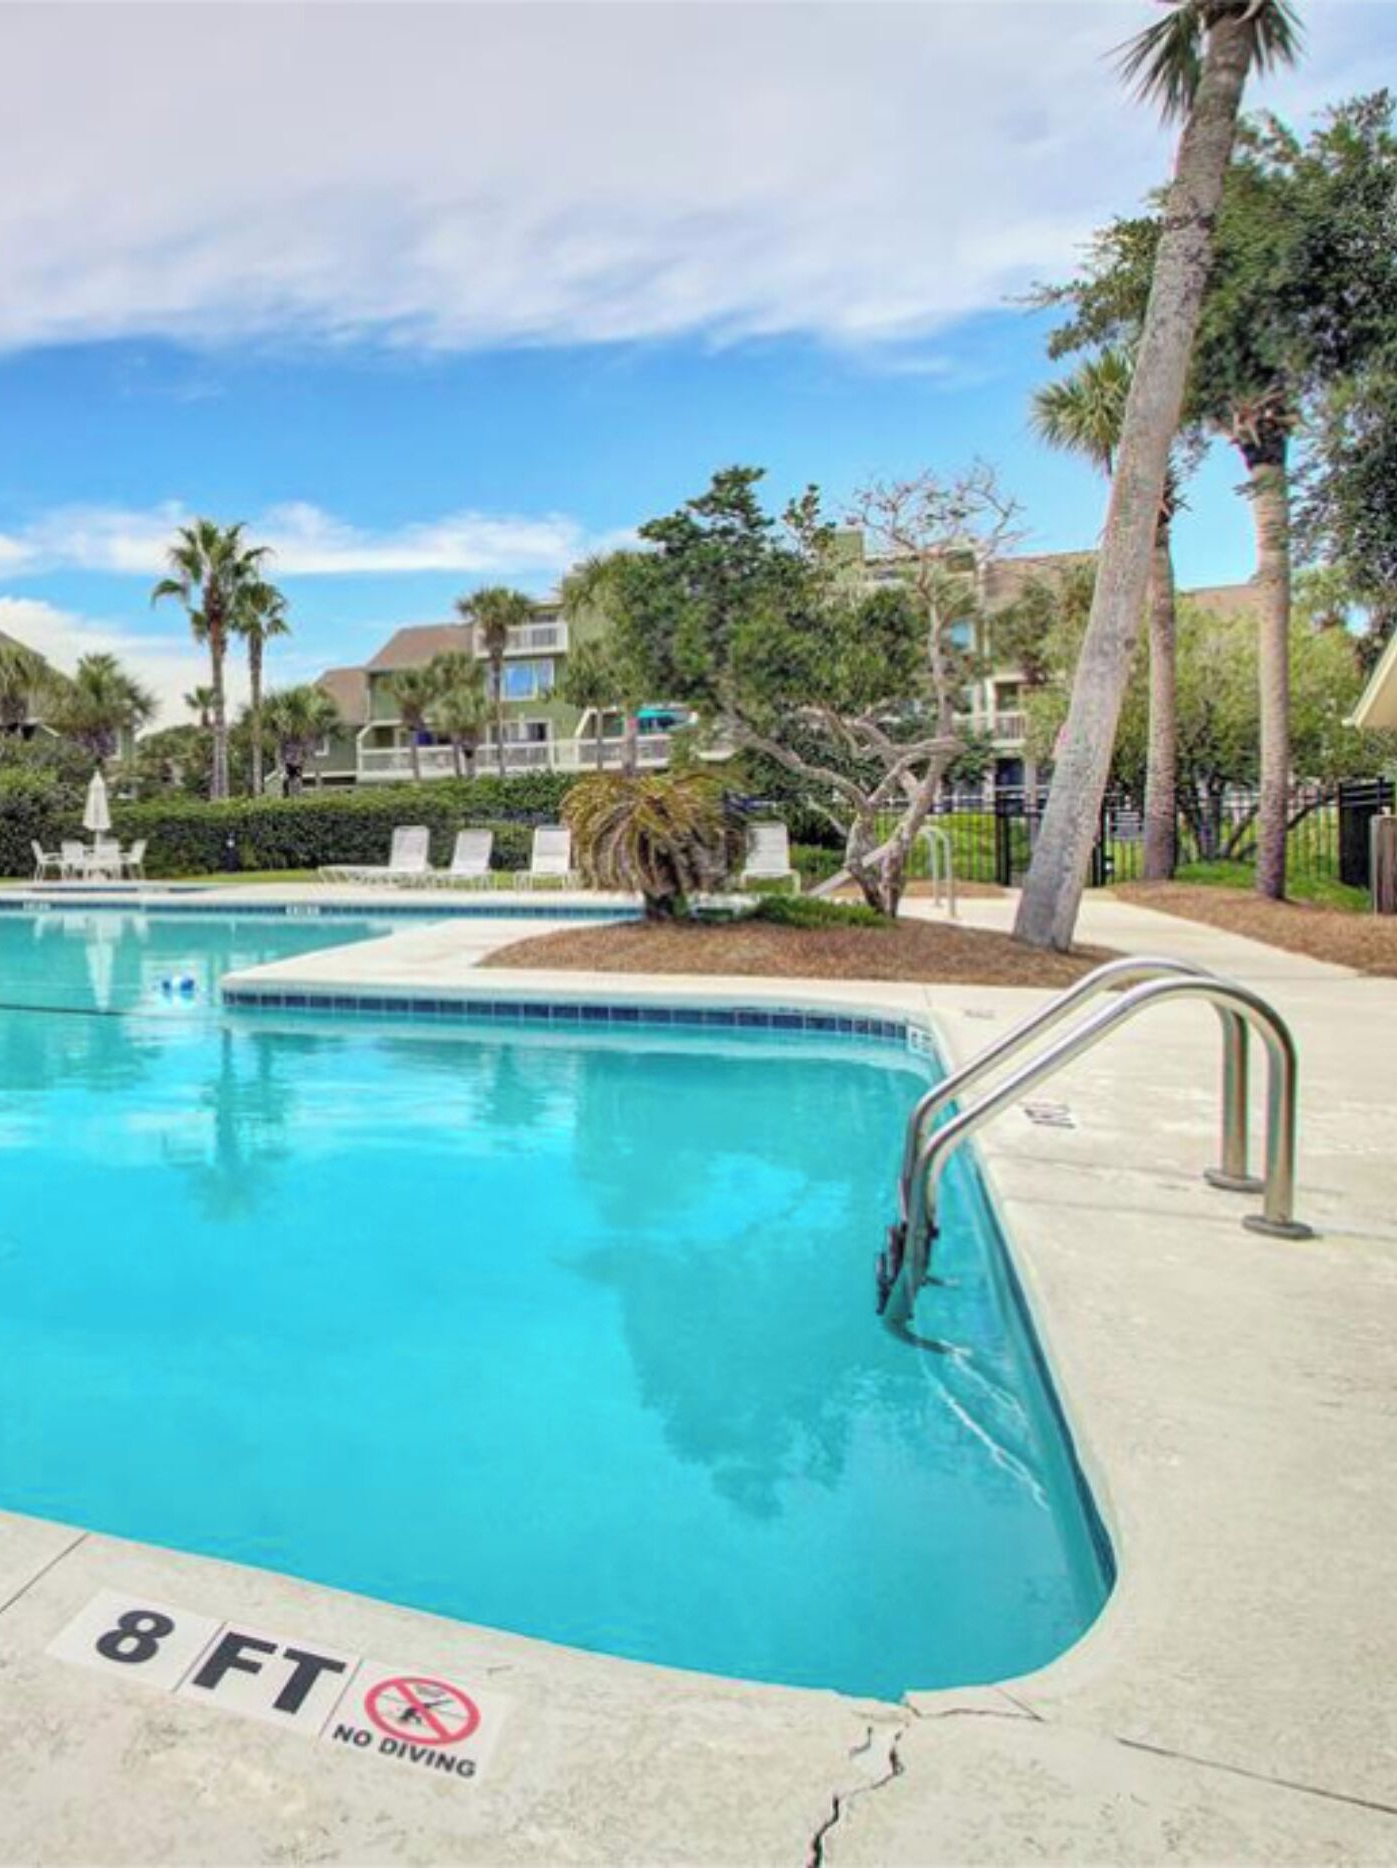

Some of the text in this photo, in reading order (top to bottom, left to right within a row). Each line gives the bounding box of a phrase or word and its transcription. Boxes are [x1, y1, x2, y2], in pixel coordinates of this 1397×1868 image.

[96, 1610, 346, 1714] 8 FT
[333, 1724, 476, 1779] NO DIVING
